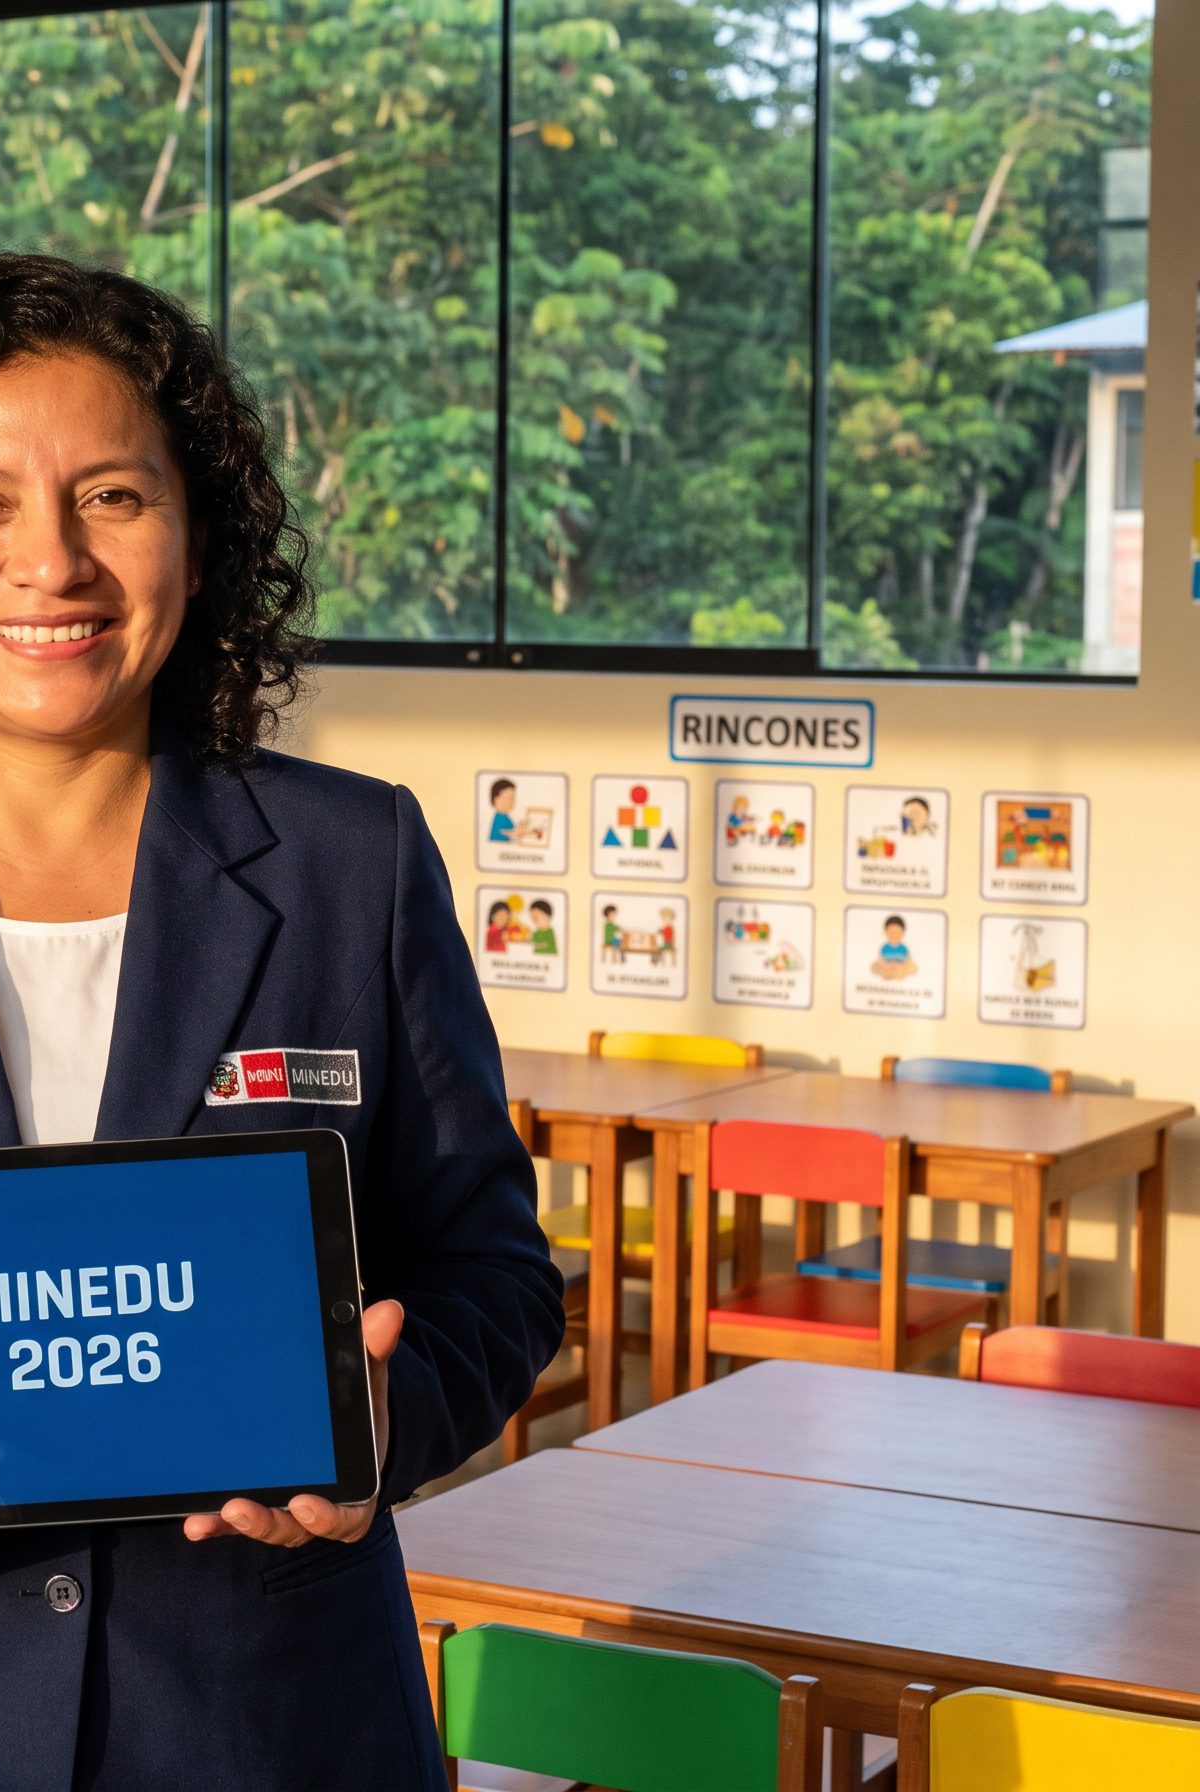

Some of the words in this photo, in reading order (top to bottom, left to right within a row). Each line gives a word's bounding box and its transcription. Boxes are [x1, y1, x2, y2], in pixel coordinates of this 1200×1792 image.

[682, 713, 860, 749] RINCONES
[291, 1068, 353, 1086] MINEDU
[9, 1332, 161, 1390] 2026
